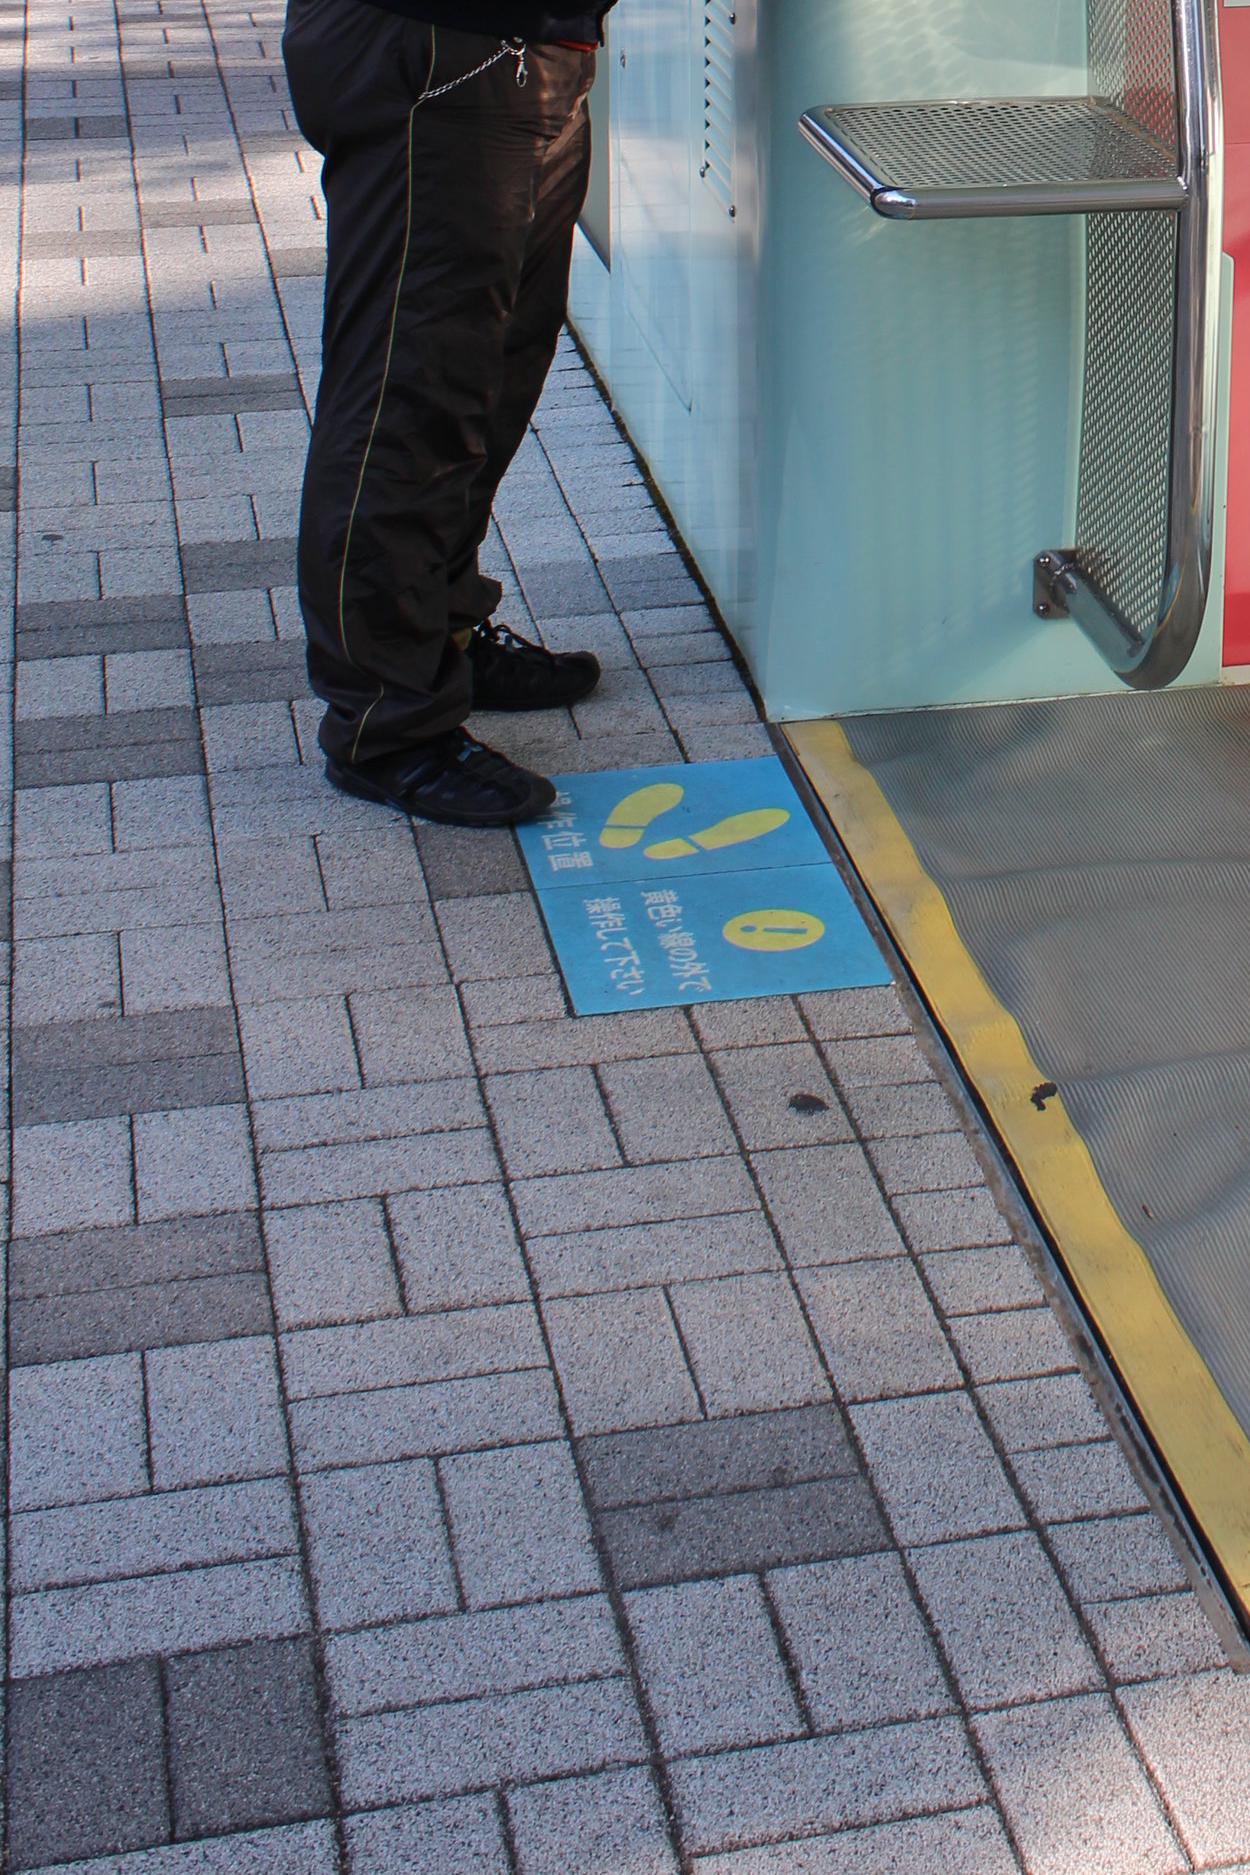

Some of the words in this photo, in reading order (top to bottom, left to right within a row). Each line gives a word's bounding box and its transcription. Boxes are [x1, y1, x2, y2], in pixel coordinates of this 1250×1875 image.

[582, 897, 645, 996] 操作して下さい
[640, 888, 712, 993] 黄色い線の外で
